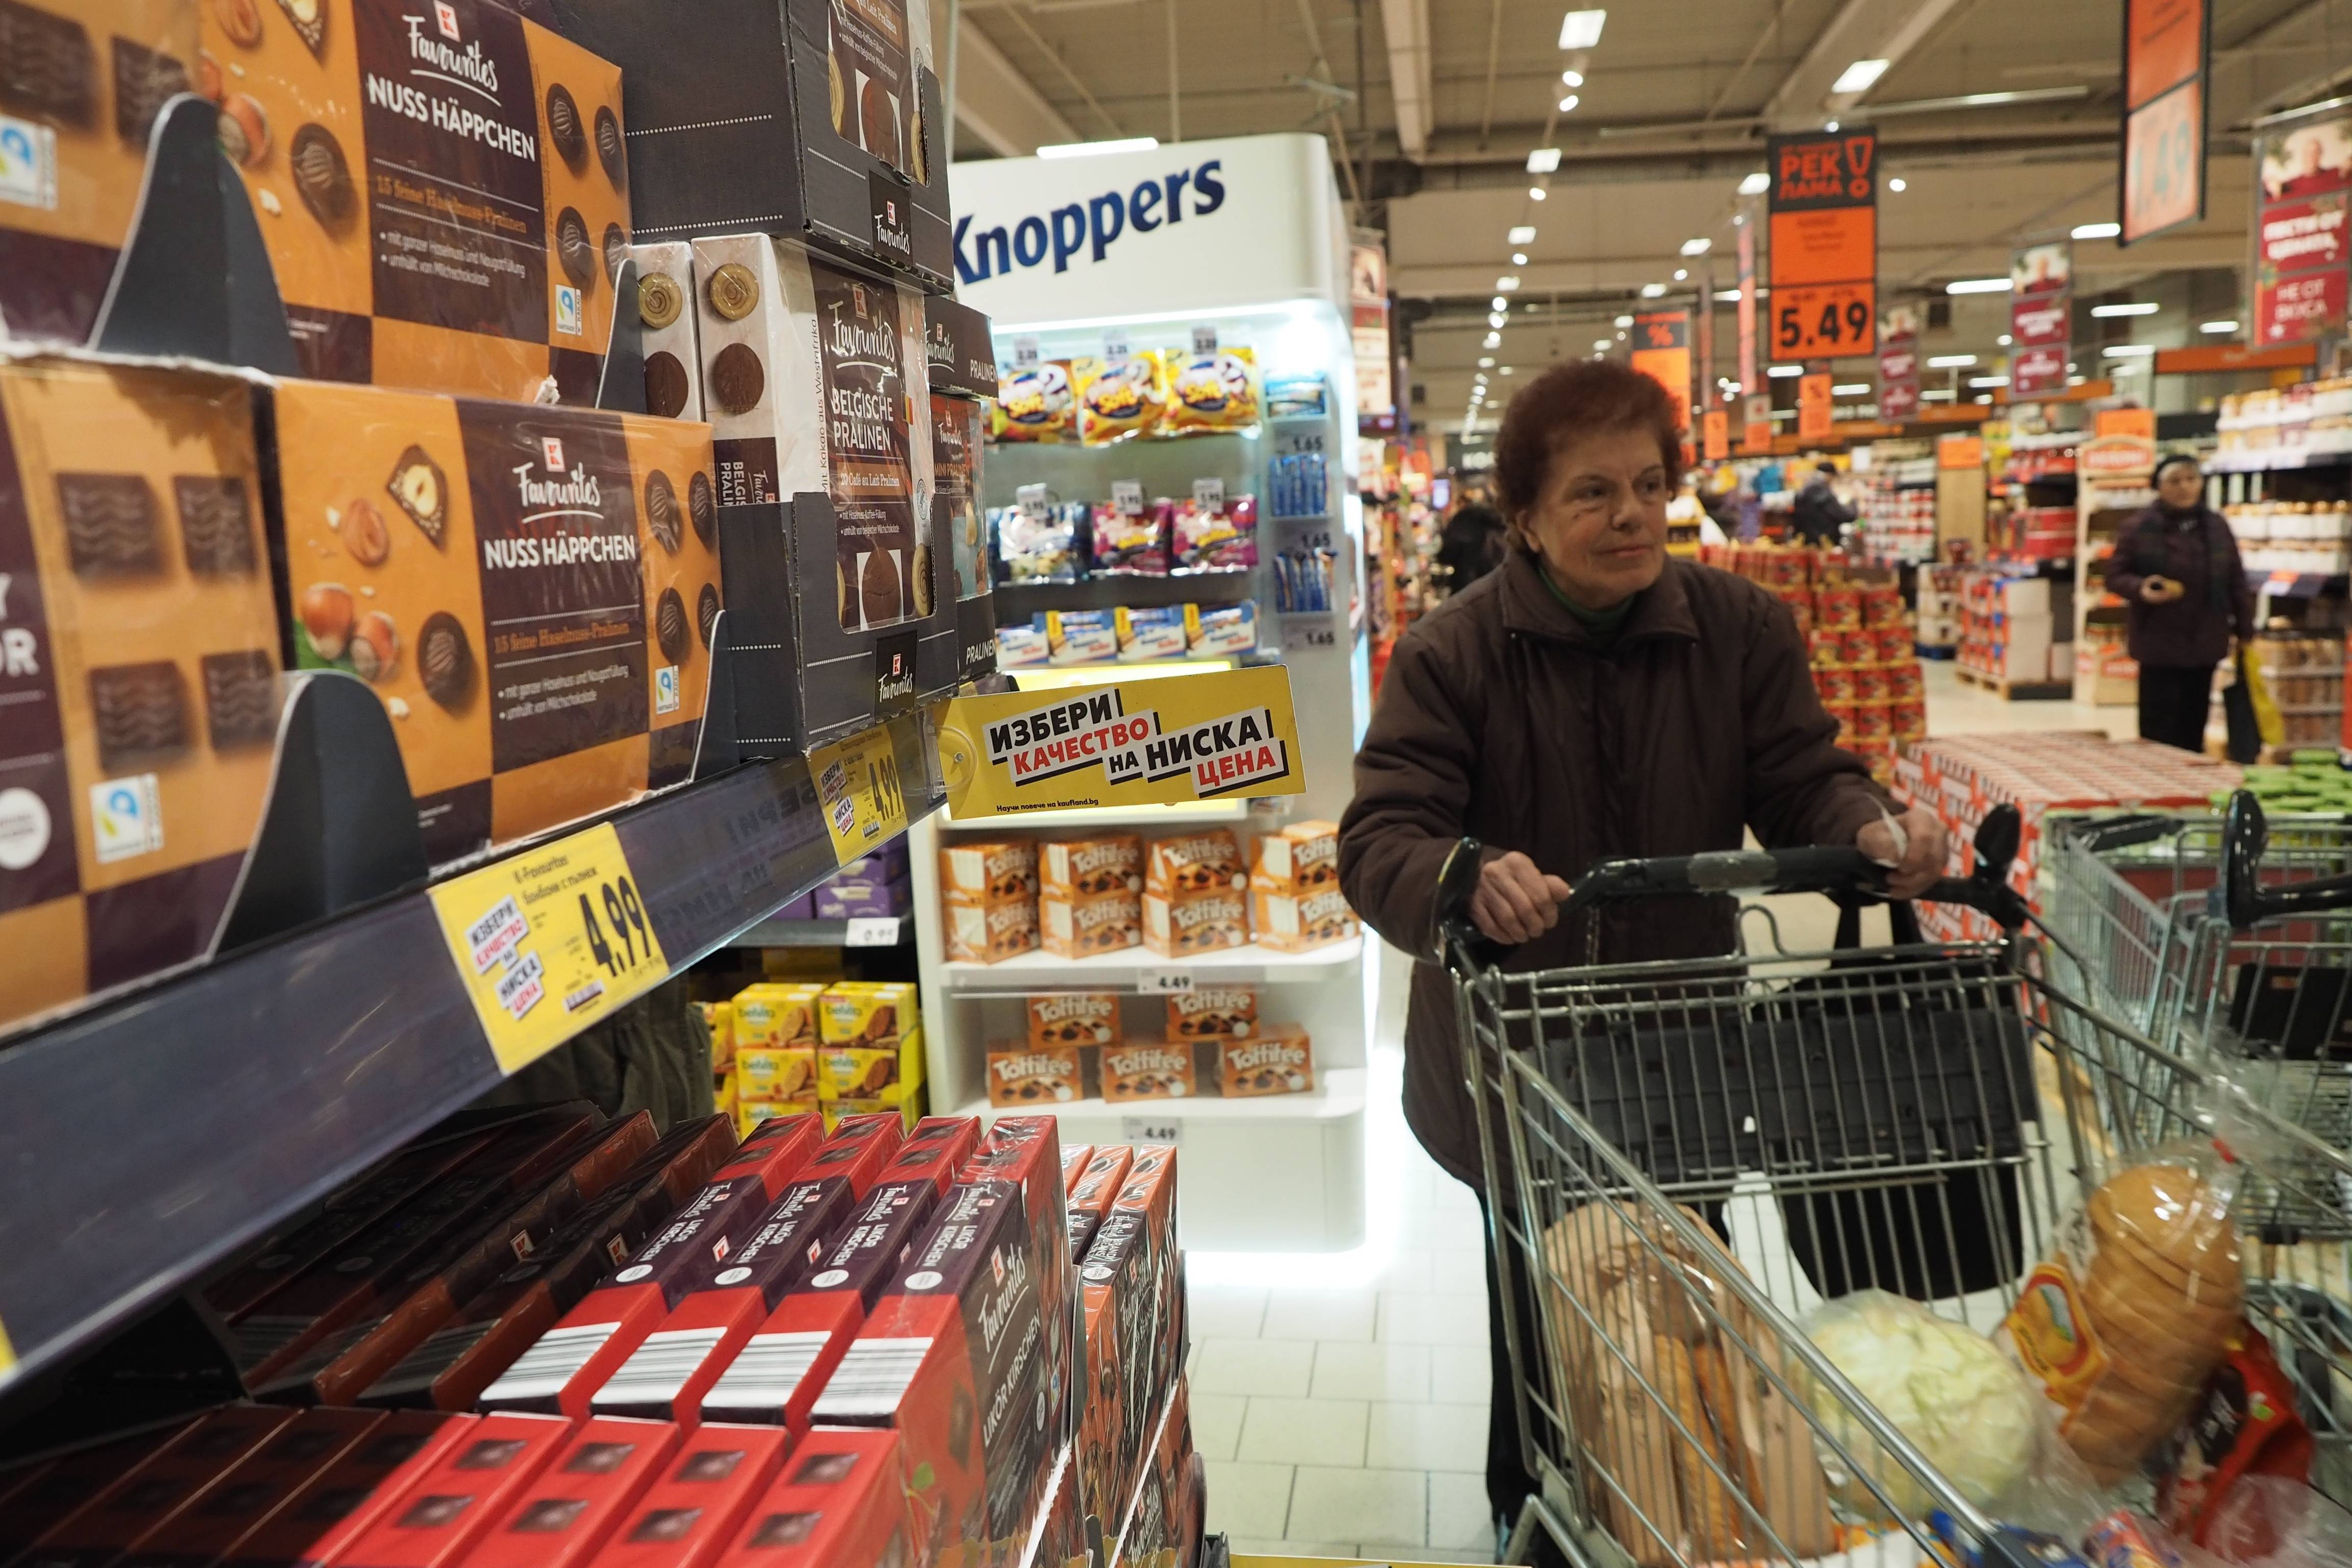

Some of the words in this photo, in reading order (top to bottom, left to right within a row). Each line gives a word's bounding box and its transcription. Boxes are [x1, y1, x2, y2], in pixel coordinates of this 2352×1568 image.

[402, 14, 498, 91] Favourites
[368, 73, 428, 123] NUSS
[432, 97, 535, 162] HÄPPCHEN
[874, 214, 910, 255] Favourites
[952, 160, 1226, 285] Knoppers
[828, 301, 894, 362] Favourites
[1780, 302, 1868, 348] 5.49
[811, 319, 822, 394] Westafrika
[831, 387, 893, 422] BELGISCHE
[819, 427, 827, 468] Kakao
[834, 420, 891, 452] PRALINEN
[512, 462, 601, 507] Favourites
[841, 473, 848, 486] 20
[849, 472, 861, 486] Café
[862, 476, 868, 485] au
[869, 473, 880, 486] Lait
[880, 474, 900, 486] Pralinen
[484, 537, 539, 570] NUSS
[542, 530, 635, 566] HÄPPCHEN
[878, 666, 913, 703] Favourites
[990, 692, 1113, 754] ИЗБЕРИ
[1014, 717, 1149, 775] КАЧЕСТВО
[1110, 751, 1139, 774] НА
[1146, 715, 1263, 772] НИСКА
[821, 762, 841, 788] ИЗБЕРИ
[1198, 745, 1276, 787] ЦЕНА
[823, 772, 845, 802] КАЧЕСТВО
[869, 754, 901, 821] 4.99
[1057, 798, 1098, 807] kaufland.bg
[834, 797, 851, 823] НИСКА
[840, 817, 852, 834] ЦЕНА
[470, 902, 514, 948] ИЗБЕРИ
[579, 876, 651, 977] 4.99
[1172, 897, 1244, 929] Toffifee
[500, 960, 538, 1000] НИСКА
[1159, 976, 1190, 989] 4.49
[1033, 994, 1113, 1023] Toffifee
[1171, 990, 1251, 1015] Toffifee
[993, 1054, 1073, 1082] Toffifee
[1107, 1049, 1187, 1076] Toffifee
[1227, 1042, 1306, 1071] Toffifee
[1144, 1126, 1176, 1140] 4.49
[830, 1225, 872, 1266] KIRSCHEN
[861, 1223, 889, 1248] LIKÖR
[922, 1226, 960, 1267] KIRSCHEN
[951, 1225, 977, 1250] LIKÖR
[978, 1242, 1026, 1353] Favourites
[983, 1383, 1008, 1448] LIKÖR
[1007, 1308, 1040, 1395] KIRSCHEN
